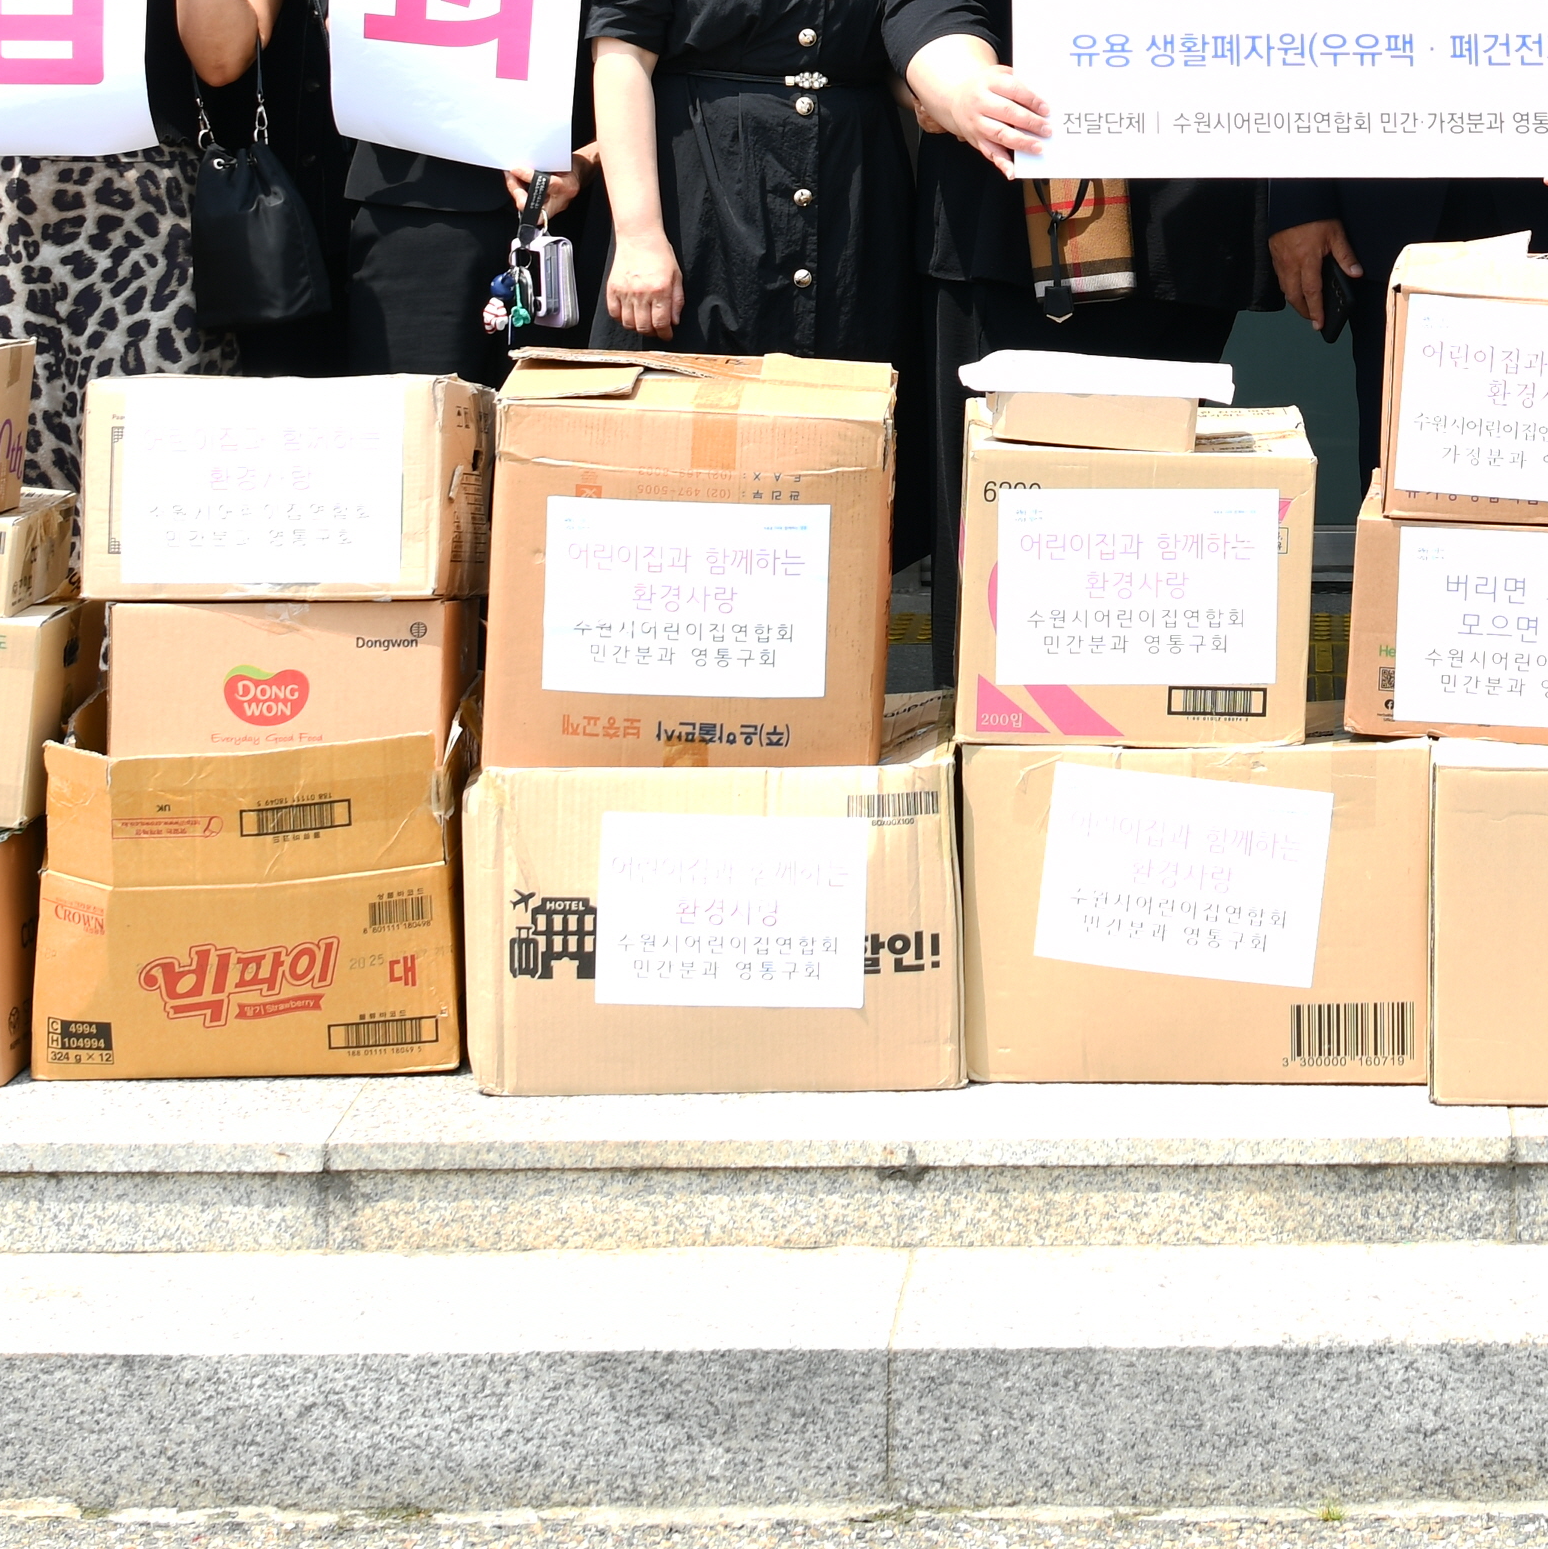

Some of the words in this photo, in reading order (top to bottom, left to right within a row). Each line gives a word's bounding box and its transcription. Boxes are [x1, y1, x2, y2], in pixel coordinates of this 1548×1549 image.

[1069, 34, 1134, 68] 유용
[1063, 110, 1146, 135] 전달단체
[1172, 110, 1373, 135] 수원시어린이집연합회
[1020, 533, 1143, 561] 어린이집과
[1156, 533, 1255, 561] 함께하는
[1086, 570, 1189, 599] 환경사랑
[1446, 574, 1527, 605] 버리면
[1027, 608, 1245, 628] 수원시어린이집연합회
[1457, 613, 1539, 644] 모으면
[355, 636, 419, 652] Dongwon
[1043, 634, 1129, 654] 민간분과
[1144, 634, 1228, 654] 영통구회
[236, 680, 299, 701] DONG
[1441, 673, 1525, 698] 민간분과
[244, 701, 291, 717] WON
[562, 713, 642, 740] 보충교재
[981, 712, 1024, 729] 200입
[210, 733, 261, 745] Everyday
[265, 732, 294, 744] Good
[299, 732, 323, 743] Food
[546, 900, 586, 911] HOTEL
[54, 904, 105, 931] CROWN
[388, 953, 418, 987] 대
[139, 936, 340, 1028] 빅파이
[266, 996, 316, 1015] Strawberry
[69, 1022, 97, 1036] 4994
[63, 1036, 105, 1050] 104994
[50, 1050, 70, 1063] 324
[99, 1051, 112, 1063] 12
[1282, 1057, 1289, 1067] 3
[1299, 1057, 1347, 1067] 300000
[1358, 1056, 1405, 1067] 160719
